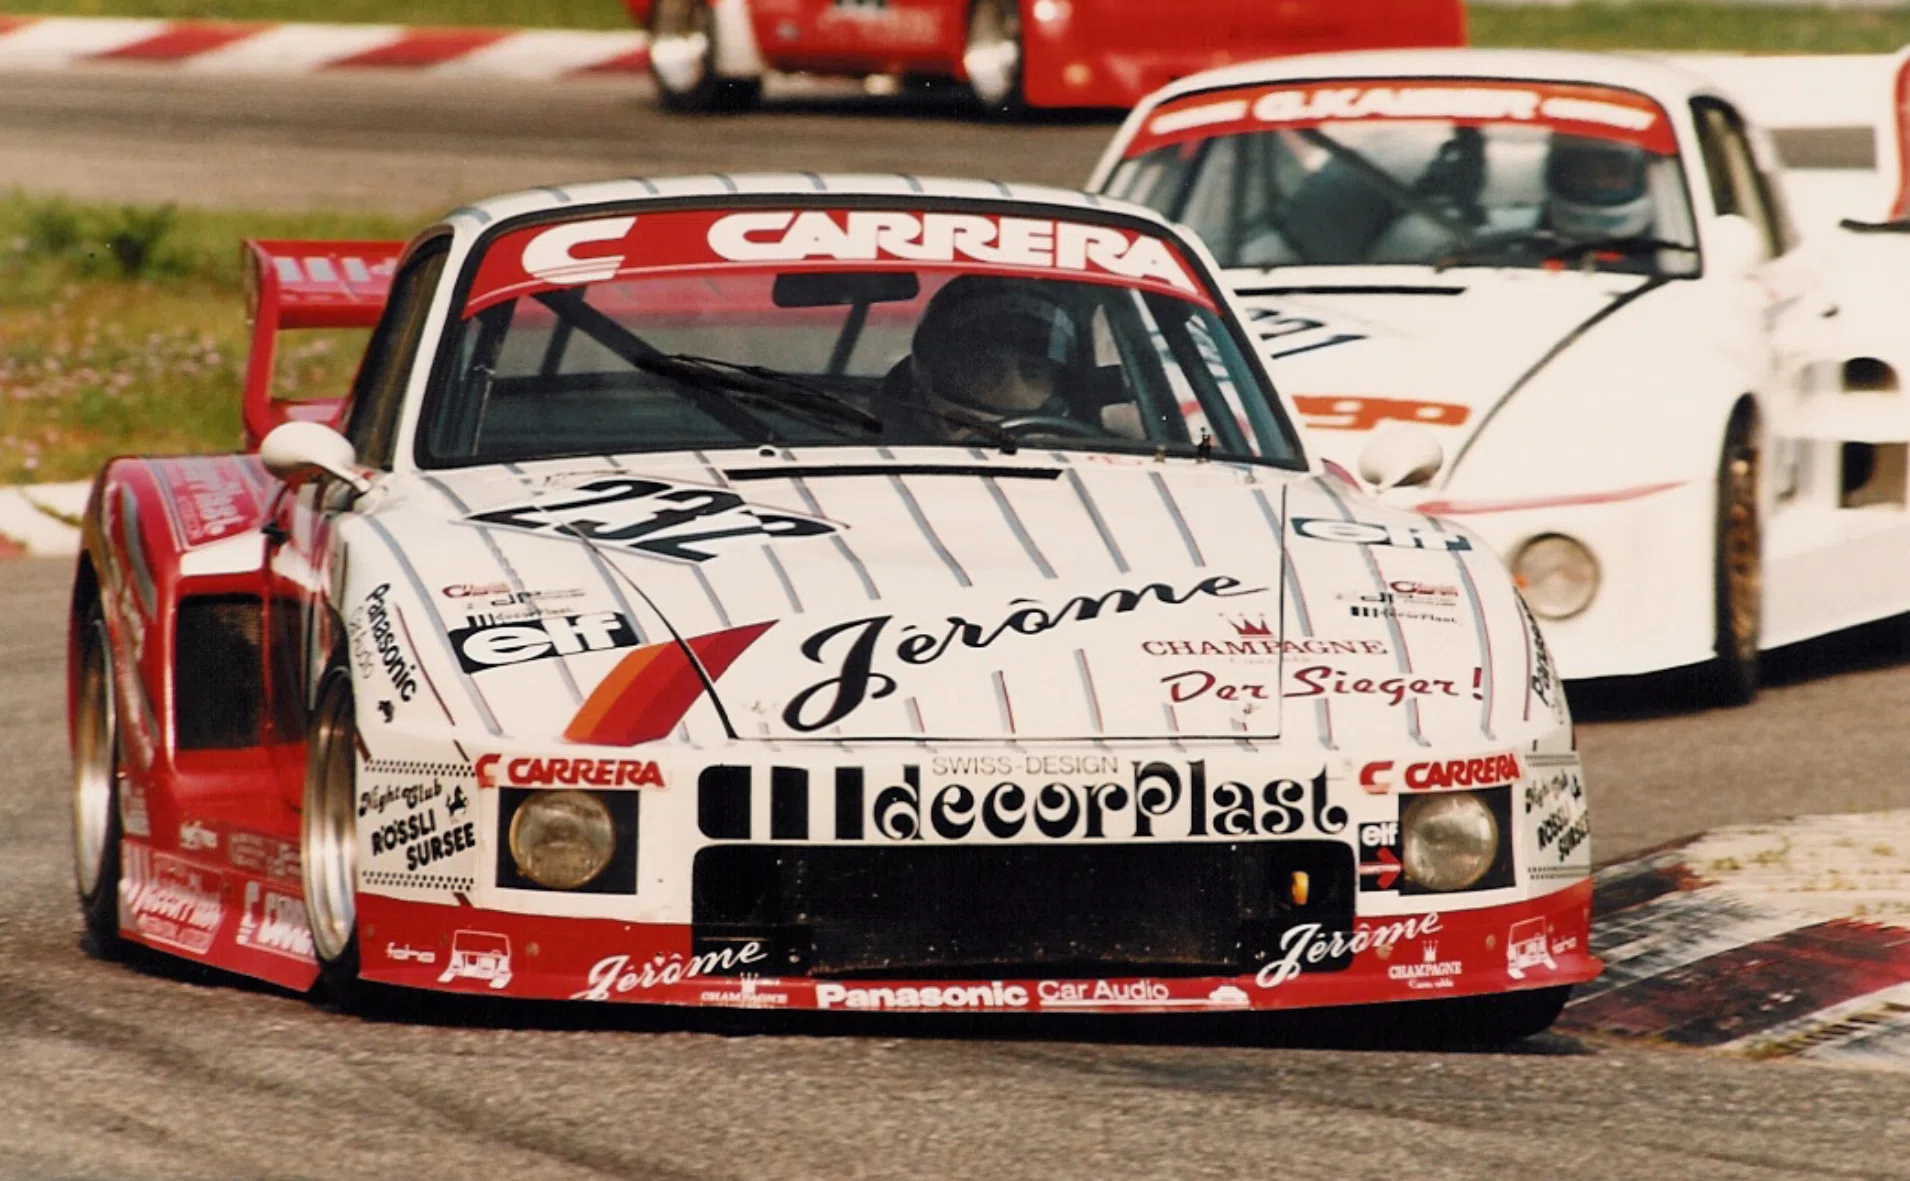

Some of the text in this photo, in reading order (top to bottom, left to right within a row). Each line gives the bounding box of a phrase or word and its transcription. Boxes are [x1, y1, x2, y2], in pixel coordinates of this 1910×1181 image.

[707, 208, 1200, 296] CARRERA
[466, 479, 838, 562] 232
[366, 583, 417, 702] Panasonic
[463, 611, 623, 665] elf
[782, 576, 1270, 732] Jérôme
[1142, 640, 1389, 655] CHAMPAGNE
[1161, 670, 1270, 702] Der
[508, 758, 666, 787] CARRERA
[932, 756, 1118, 775] SWISS-DESIGN
[1404, 753, 1520, 790] CARRERA
[371, 808, 437, 857] RÖSSLI
[406, 821, 476, 871] SURSEE
[1361, 822, 1400, 846] elf
[570, 941, 768, 1001] Jérôme
[1256, 912, 1443, 988] Jérôme
[1388, 961, 1463, 980] CHAMPAGNE
[815, 980, 1170, 1008] Panasonic Car Audio
